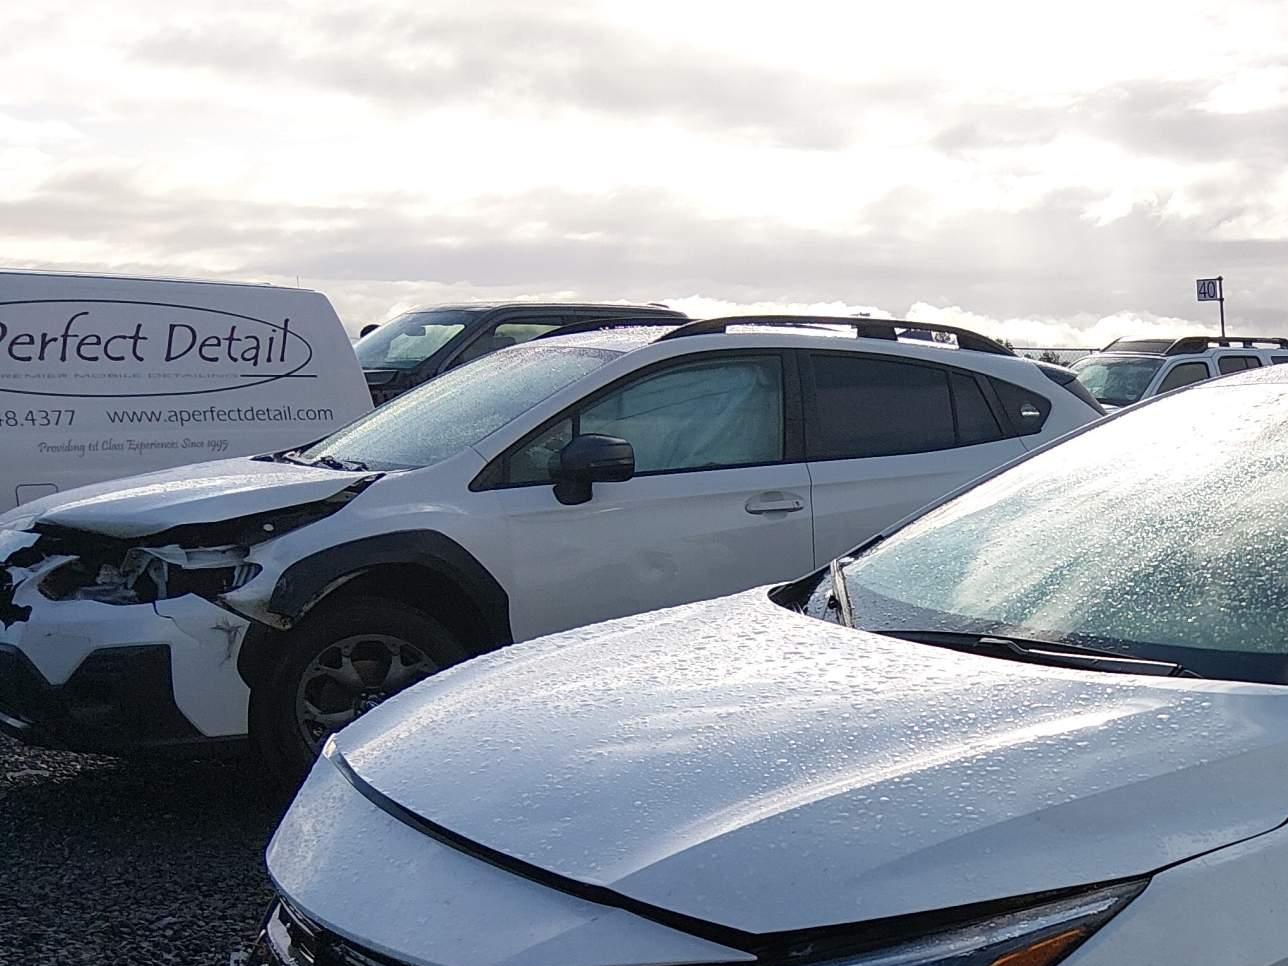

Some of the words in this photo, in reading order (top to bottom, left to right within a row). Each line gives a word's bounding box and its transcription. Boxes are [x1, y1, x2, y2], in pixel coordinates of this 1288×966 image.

[1199, 281, 1216, 298] 40
[164, 318, 290, 367] Detail
[106, 405, 334, 427] www.aperfectdetail.com
[38, 438, 86, 458] Providing
[101, 437, 125, 451] Class
[126, 439, 179, 456] Experiences
[181, 437, 205, 449] Since
